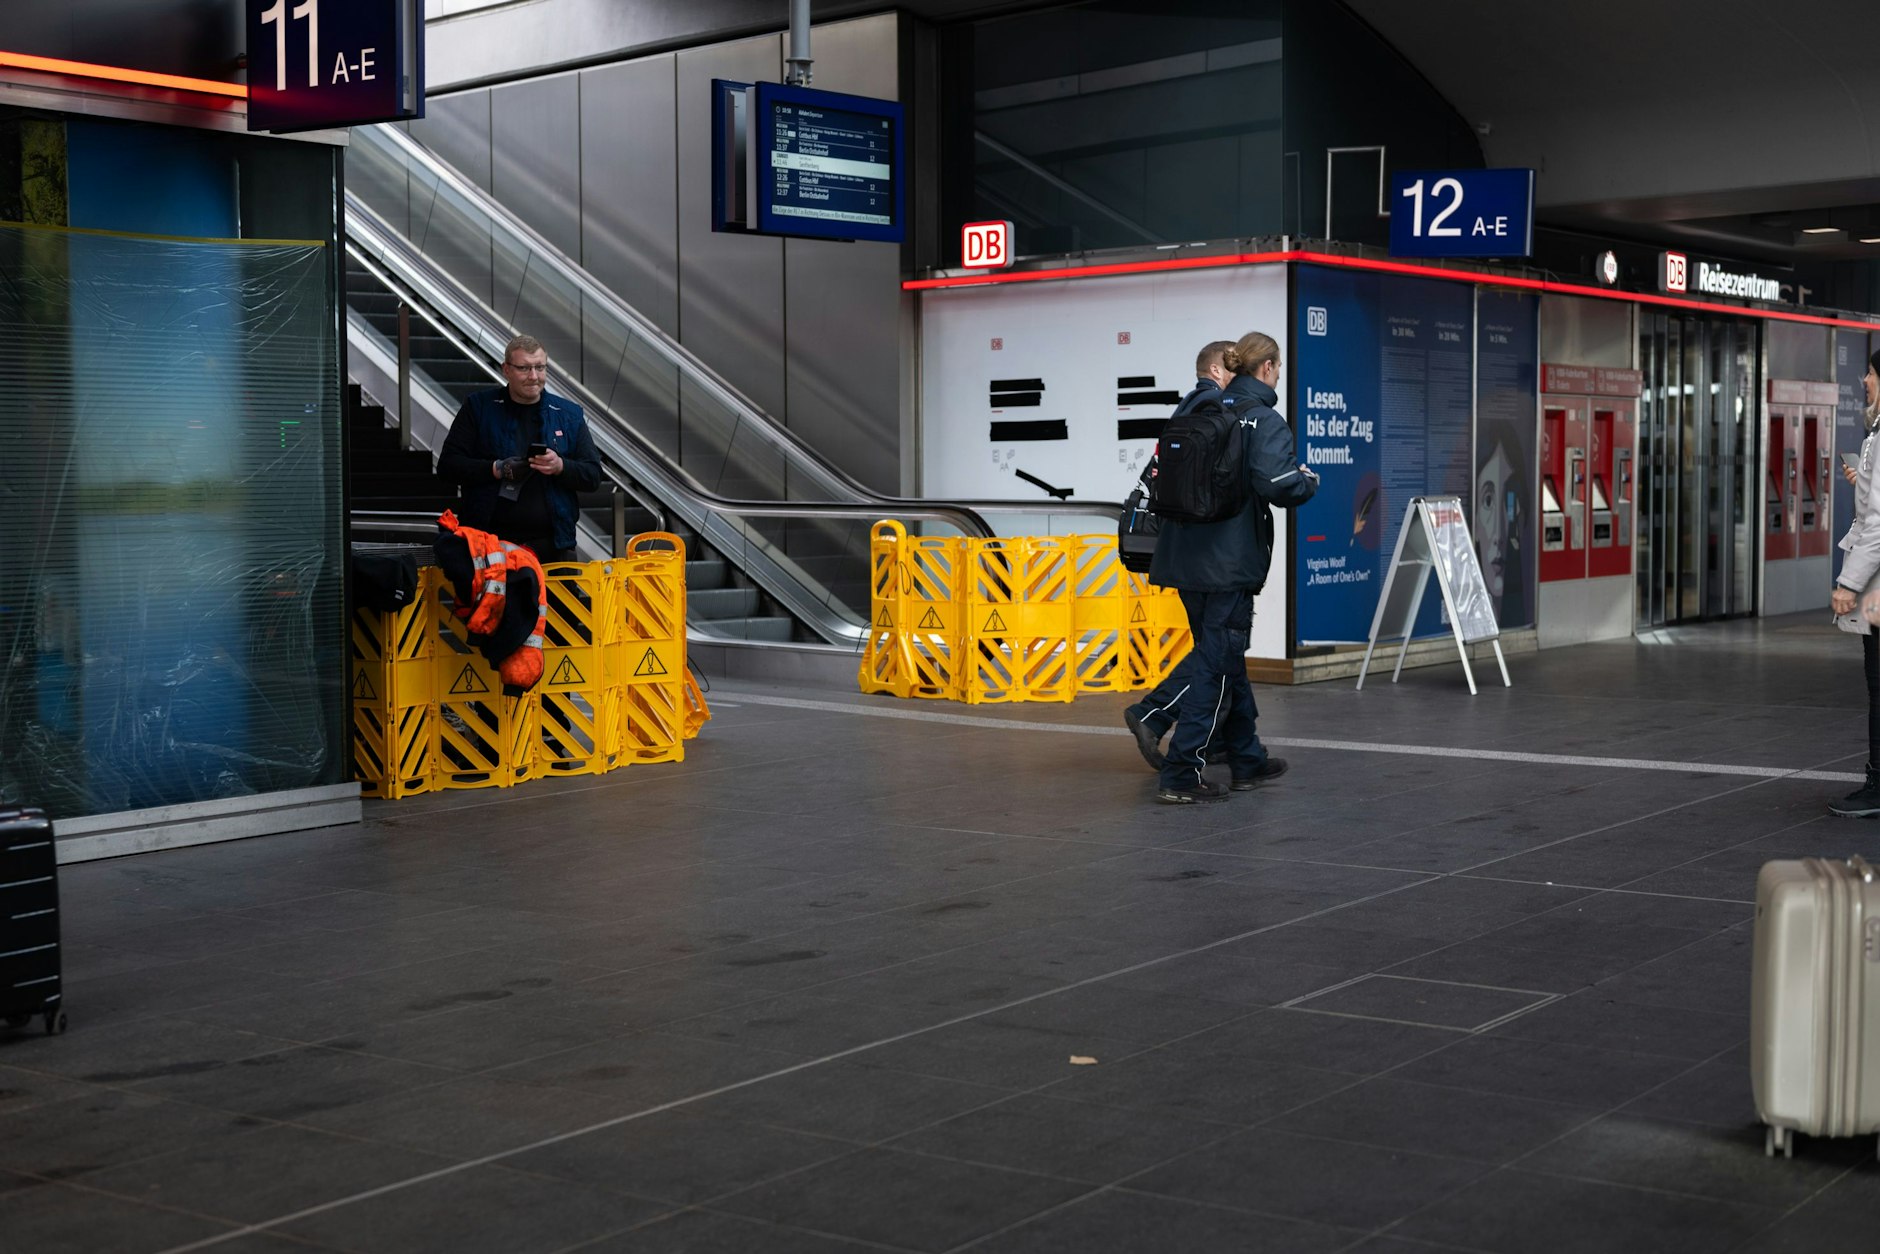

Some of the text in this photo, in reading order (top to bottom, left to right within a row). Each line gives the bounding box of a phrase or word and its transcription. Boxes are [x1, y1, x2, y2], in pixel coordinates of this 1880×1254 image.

[261, 0, 375, 91] 11 A-E
[1403, 178, 1508, 236] 12 A-E
[968, 230, 1001, 261] DB
[1670, 259, 1780, 300] DB Reisezentrum
[1310, 311, 1325, 331] DB
[1307, 387, 1347, 413] Lesen,
[1307, 414, 1374, 443] bis der Zug
[1307, 442, 1354, 464] kommt.
[1307, 556, 1346, 572] Virginia Woolf
[1315, 573, 1332, 584] Room
[1333, 572, 1340, 583] of
